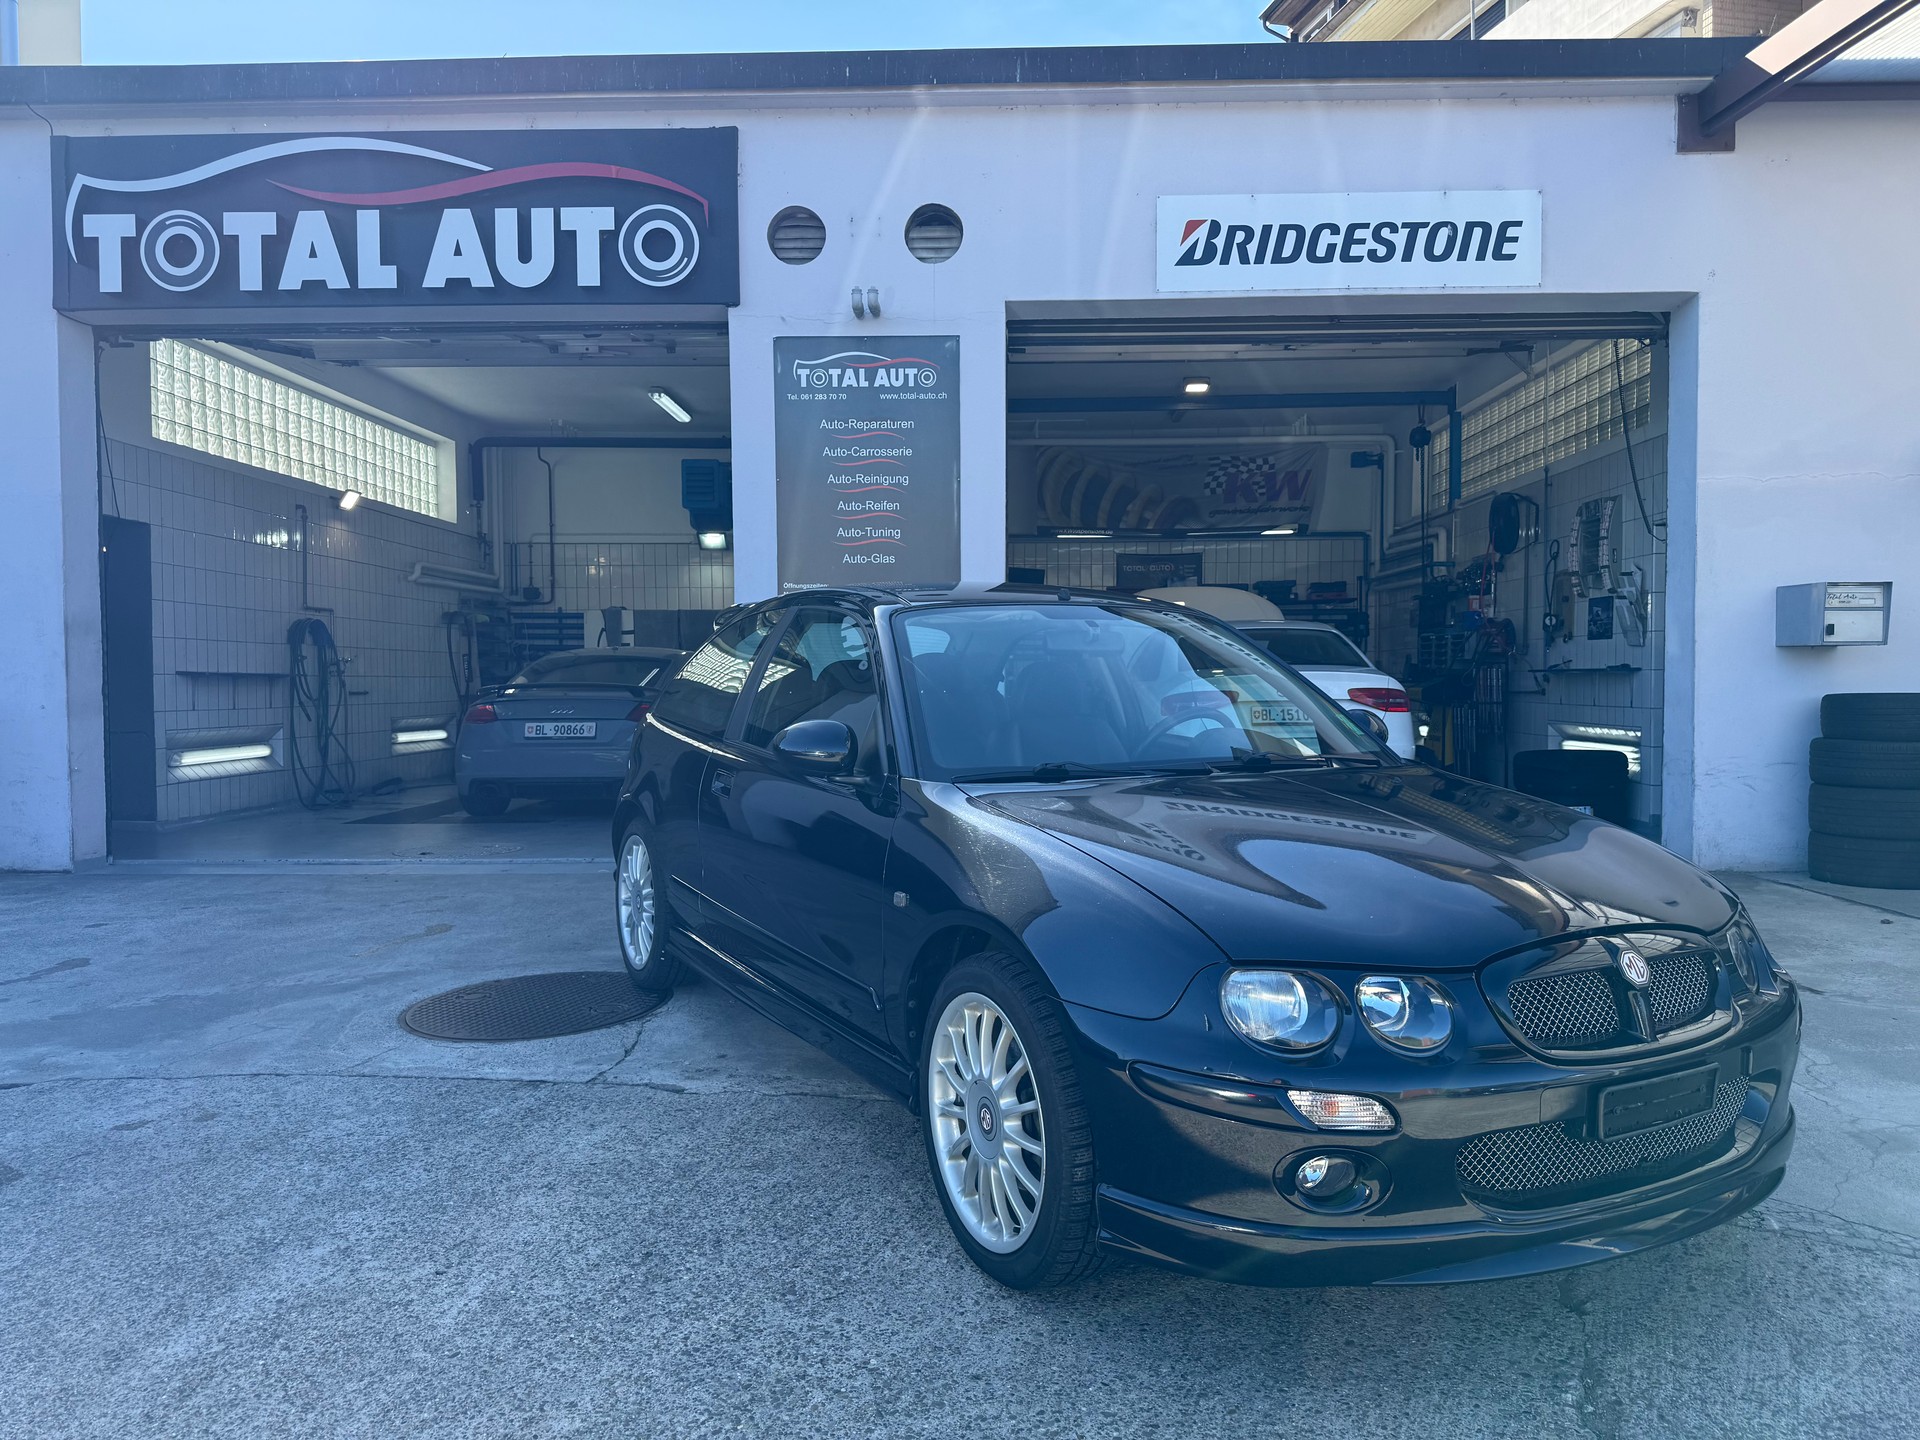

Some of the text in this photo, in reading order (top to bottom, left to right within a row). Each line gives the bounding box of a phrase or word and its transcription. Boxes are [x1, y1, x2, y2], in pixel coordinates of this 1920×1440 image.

[83, 204, 700, 292] TOTAL AUTO
[1174, 218, 1523, 267] BRIDGESTONE
[797, 367, 937, 388] TOTAL AUTO
[879, 392, 948, 400] www.total-auto.ch
[819, 419, 915, 431] Auto-Reparaturen
[822, 446, 913, 457] Auto-Carrosserie
[827, 473, 909, 486] Auto-Reinigung
[1223, 469, 1312, 503] KW
[837, 500, 900, 511] Auto-Reifen
[836, 527, 901, 539] Auto-Tuning
[842, 553, 896, 564] Auto-Glas
